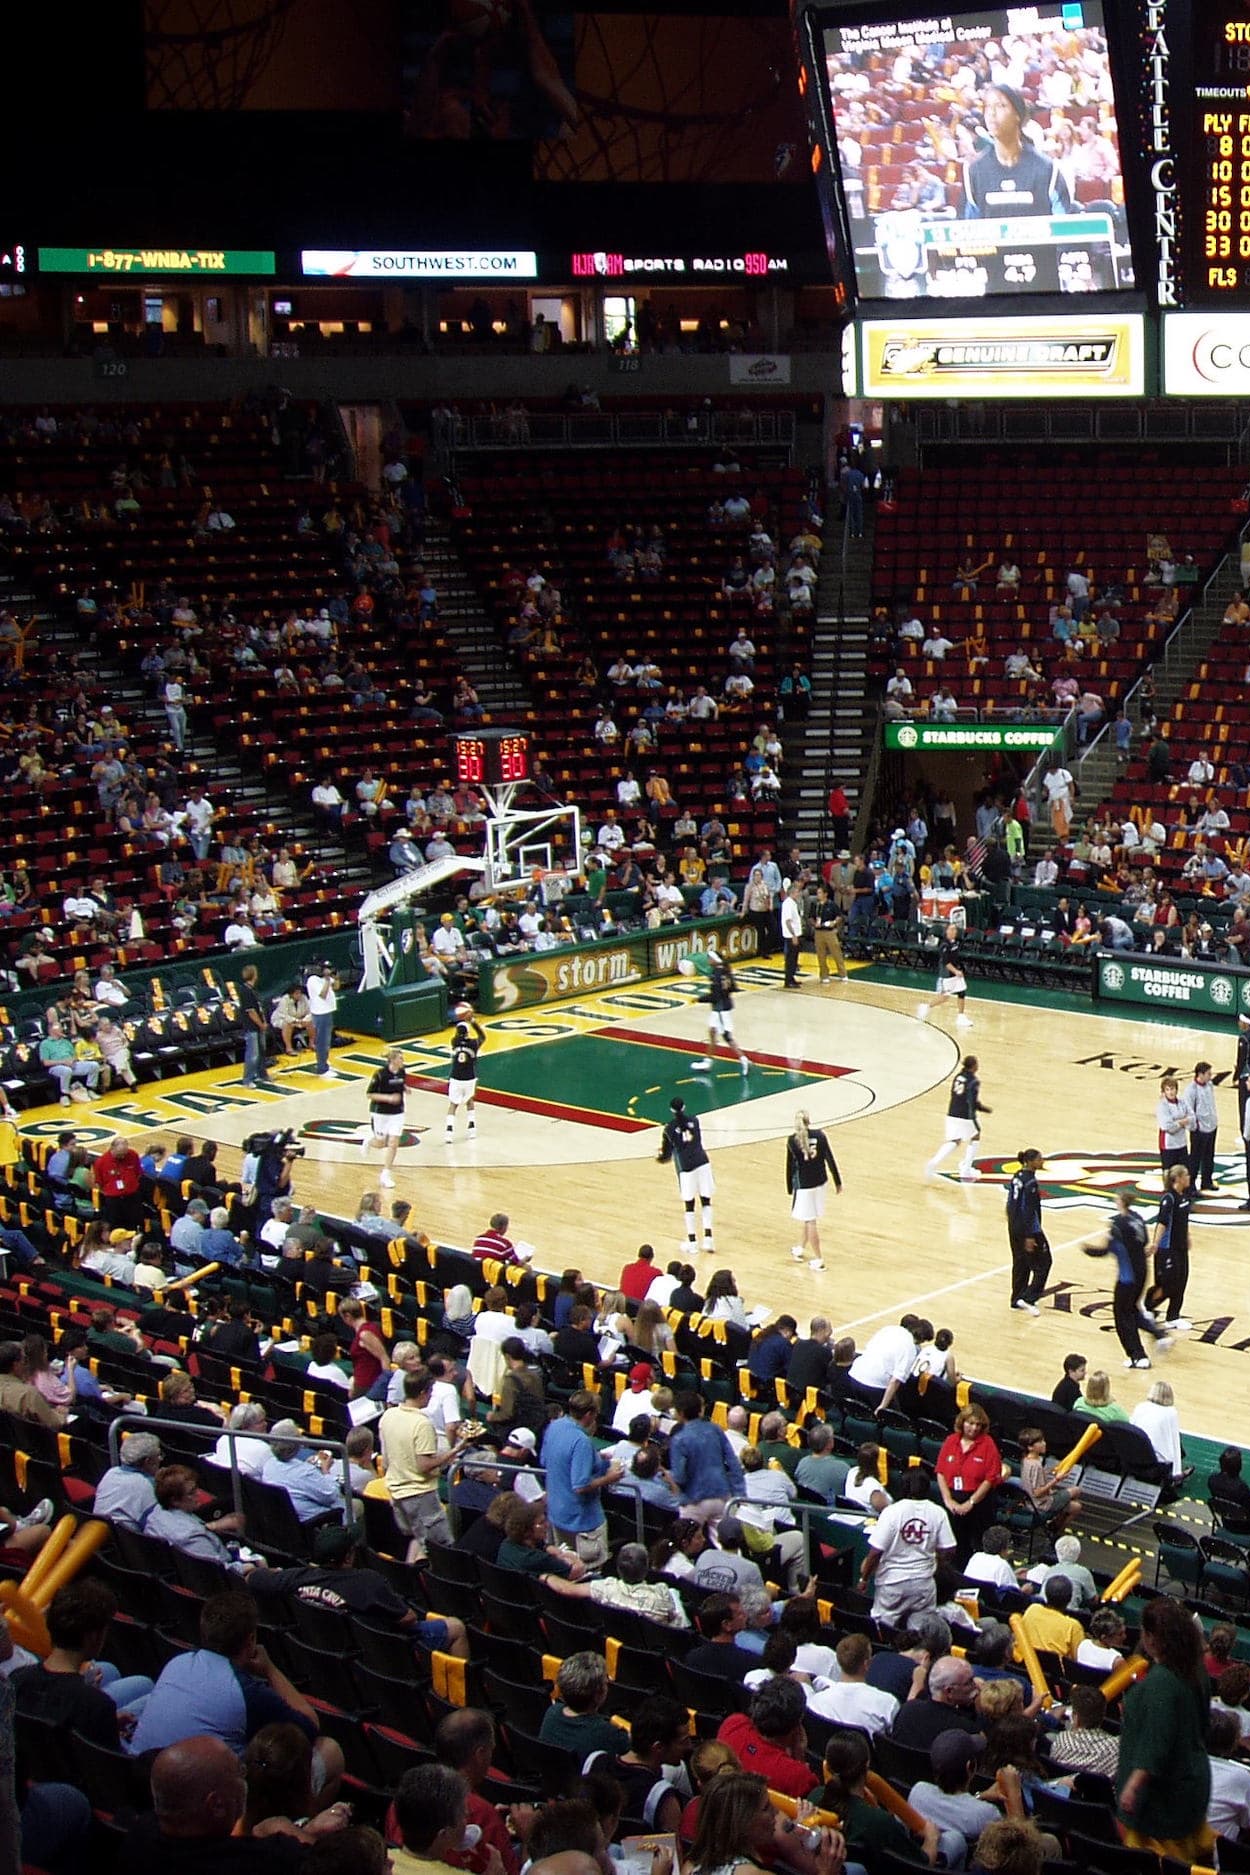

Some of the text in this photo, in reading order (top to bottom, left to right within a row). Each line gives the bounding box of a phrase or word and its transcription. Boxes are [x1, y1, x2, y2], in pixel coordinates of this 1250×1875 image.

[1147, 0, 1170, 151] EATTLE
[1195, 87, 1246, 98] TIMEOUTS
[1204, 115, 1232, 133] PLY
[1220, 135, 1233, 157] 8
[1212, 161, 1232, 182] 10
[1211, 186, 1232, 207] 15
[1205, 211, 1232, 232] 30
[1151, 159, 1177, 306] CENTER
[1205, 236, 1231, 257] 33
[88, 251, 226, 270] 1-877-WNBA-TIX
[372, 254, 518, 271] SOUTHWEST.COM
[624, 258, 685, 271] SPORTS
[693, 258, 745, 271] RADIO
[745, 253, 768, 275] 950
[768, 258, 788, 270] AM
[1209, 268, 1237, 287] FLS
[937, 345, 1031, 364] GENUINE
[103, 363, 127, 376] 120
[456, 740, 484, 755] 15:27
[500, 737, 527, 754] 15:27
[922, 730, 1002, 745] STARBUCKS
[459, 755, 481, 780] 30
[501, 752, 524, 779] 30
[1130, 966, 1205, 989] STARBUCKS
[1143, 981, 1190, 1001] COFFEE
